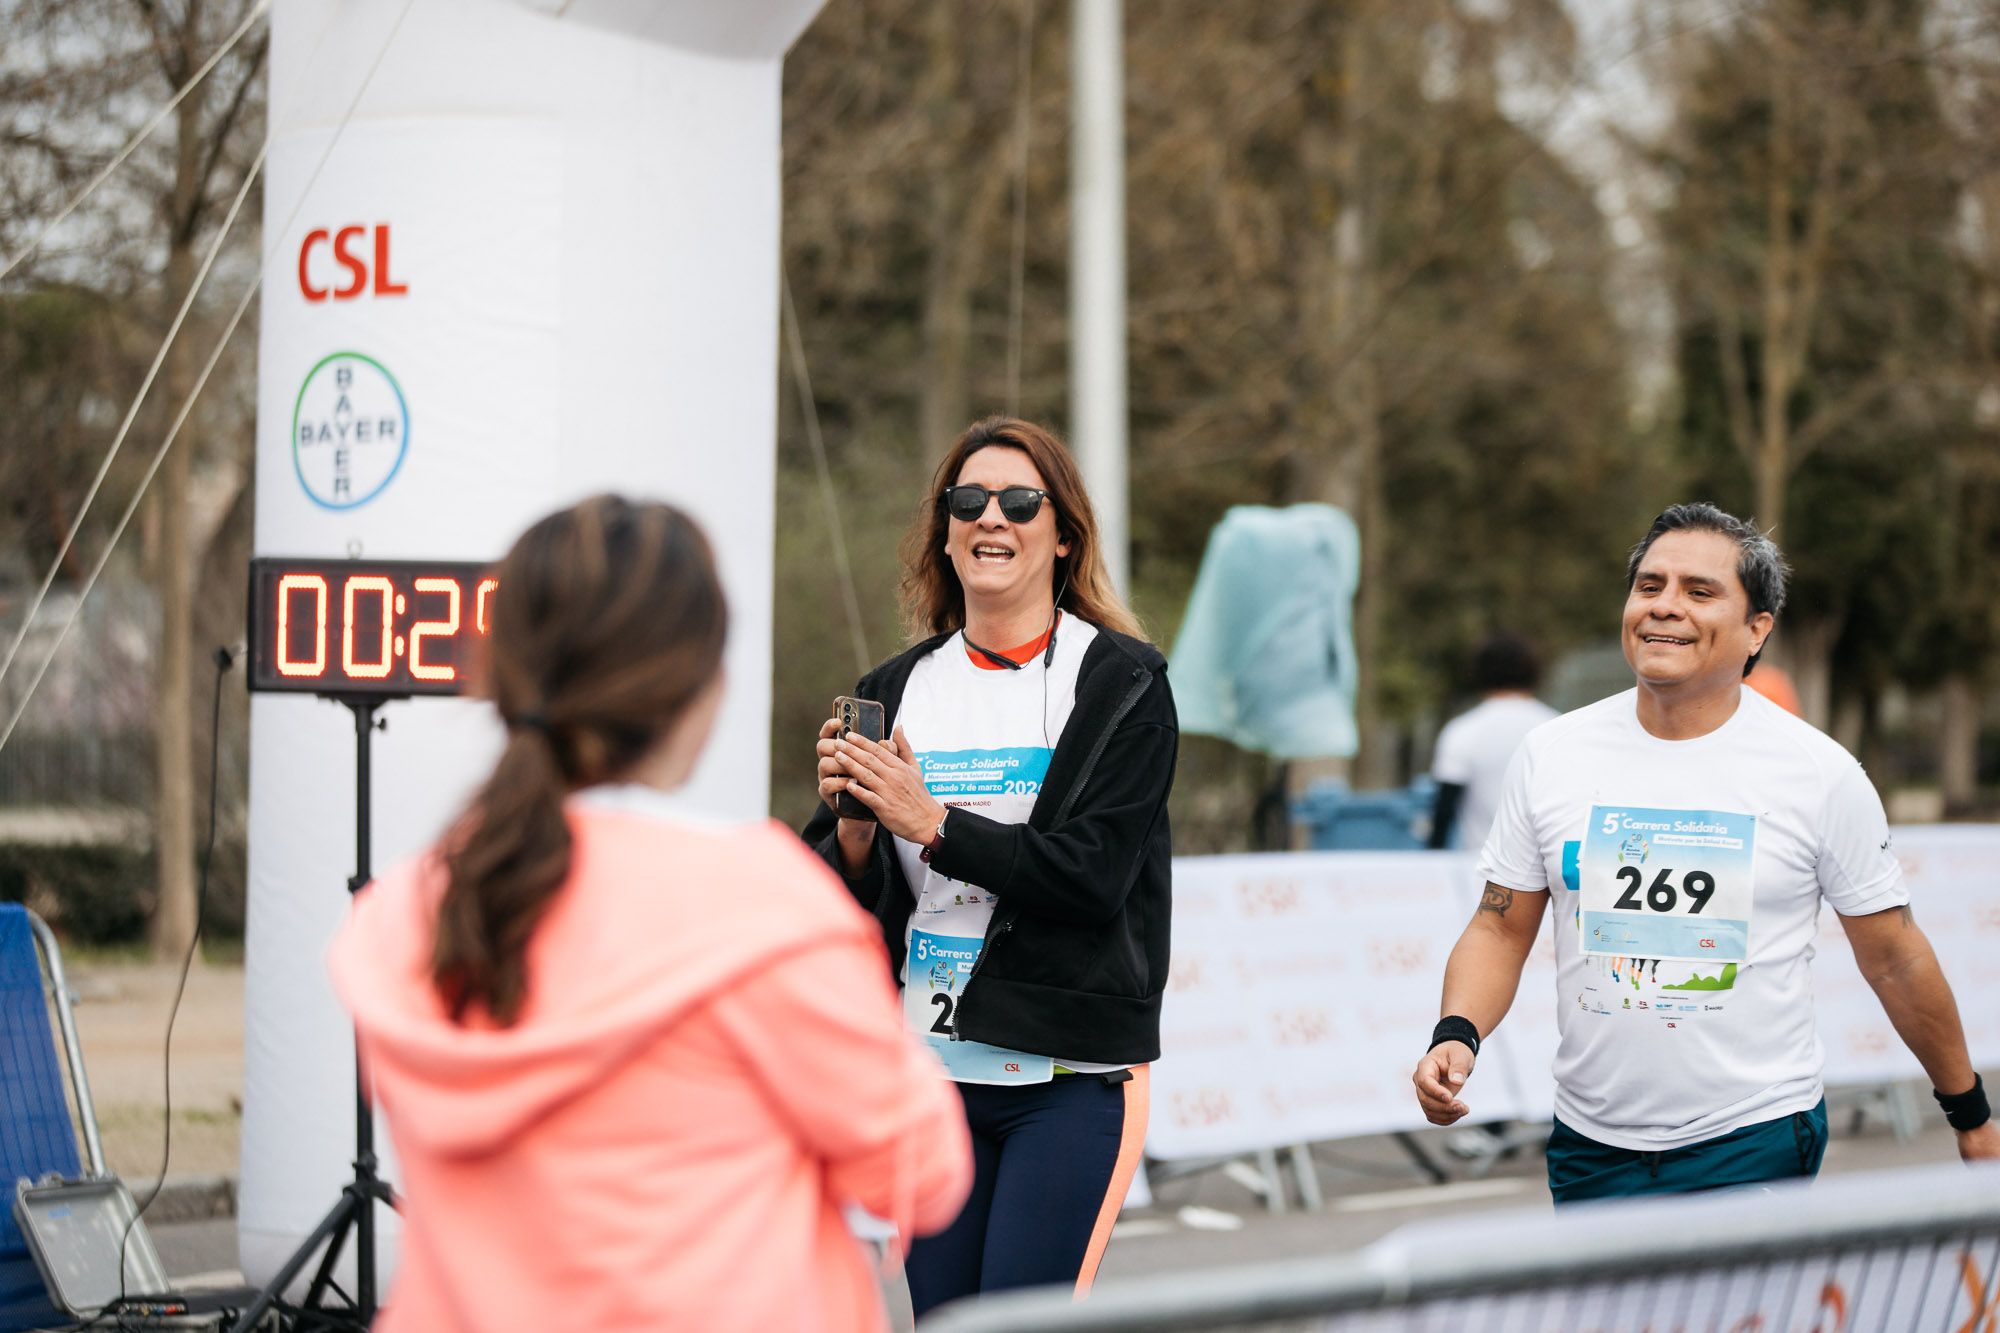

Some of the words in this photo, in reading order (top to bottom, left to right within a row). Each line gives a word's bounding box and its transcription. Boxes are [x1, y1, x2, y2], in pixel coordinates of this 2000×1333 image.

[298, 223, 409, 302] CSL
[300, 419, 397, 447] BAYER
[335, 366, 352, 496] BAYER
[925, 760, 968, 770] Carrera
[970, 757, 1019, 769] Solidaria
[931, 784, 959, 793] Sábado
[961, 784, 966, 792] 7
[967, 783, 976, 792] de
[1622, 818, 1671, 832] Carrera
[1673, 820, 1728, 835] Solidaria
[1613, 866, 1716, 914] 269
[1699, 938, 1716, 949] CSL
[929, 945, 973, 960] Carrera
[930, 992, 961, 1035] 2
[1004, 1063, 1021, 1073] CSL
